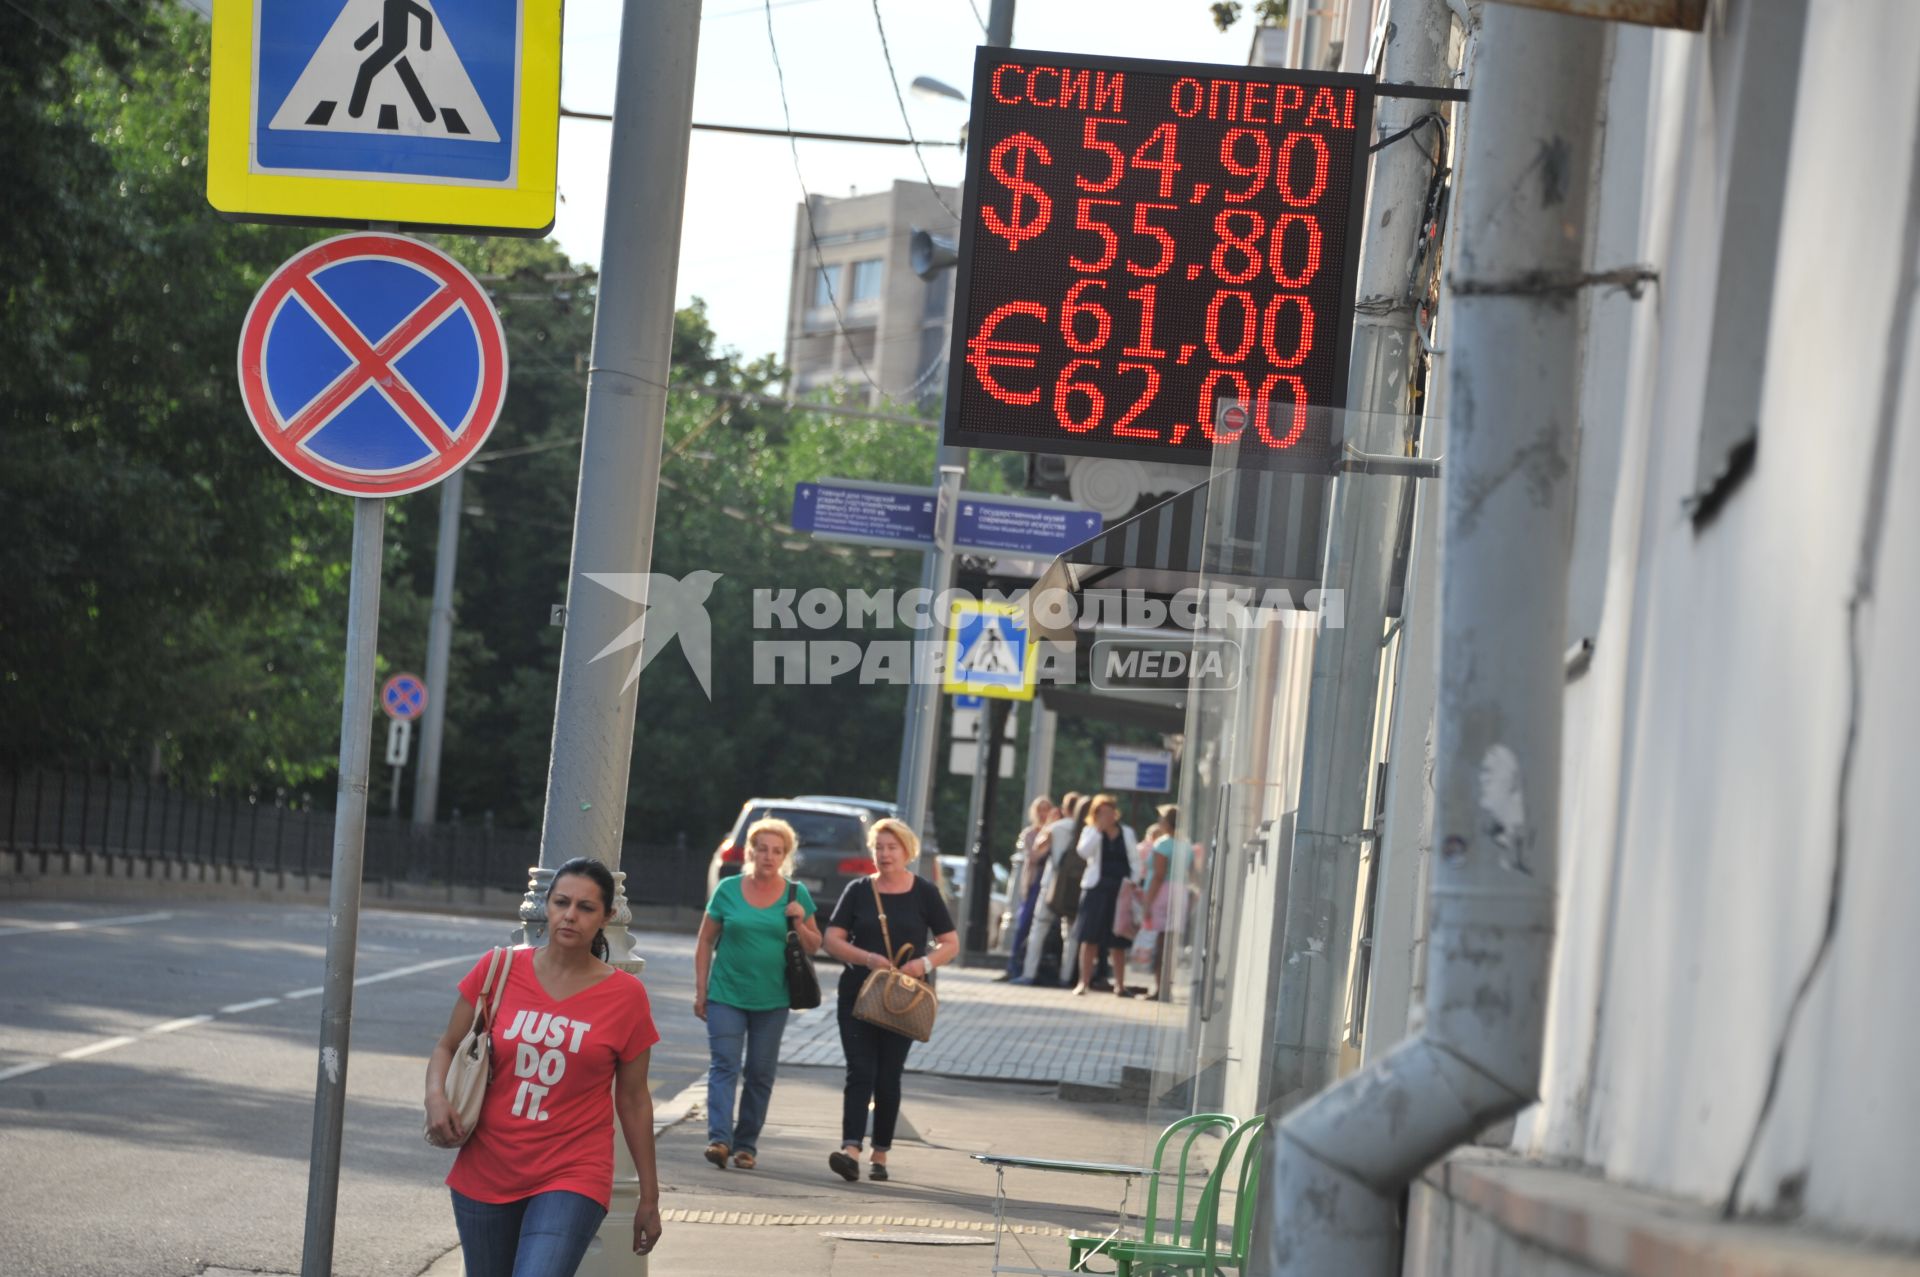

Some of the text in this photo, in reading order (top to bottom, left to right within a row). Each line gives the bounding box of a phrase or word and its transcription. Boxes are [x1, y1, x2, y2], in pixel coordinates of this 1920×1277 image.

[992, 63, 1124, 112] ССИИ
[981, 131, 1053, 251] $
[1076, 117, 1330, 207] 54,90
[1068, 198, 1322, 288] 55,80
[966, 301, 1048, 406] €
[1059, 279, 1315, 368] 61,00
[1053, 358, 1308, 449] 62,00
[503, 1010, 591, 1053] JUST
[514, 1043, 566, 1086] DO
[511, 1080, 550, 1121] IT.
